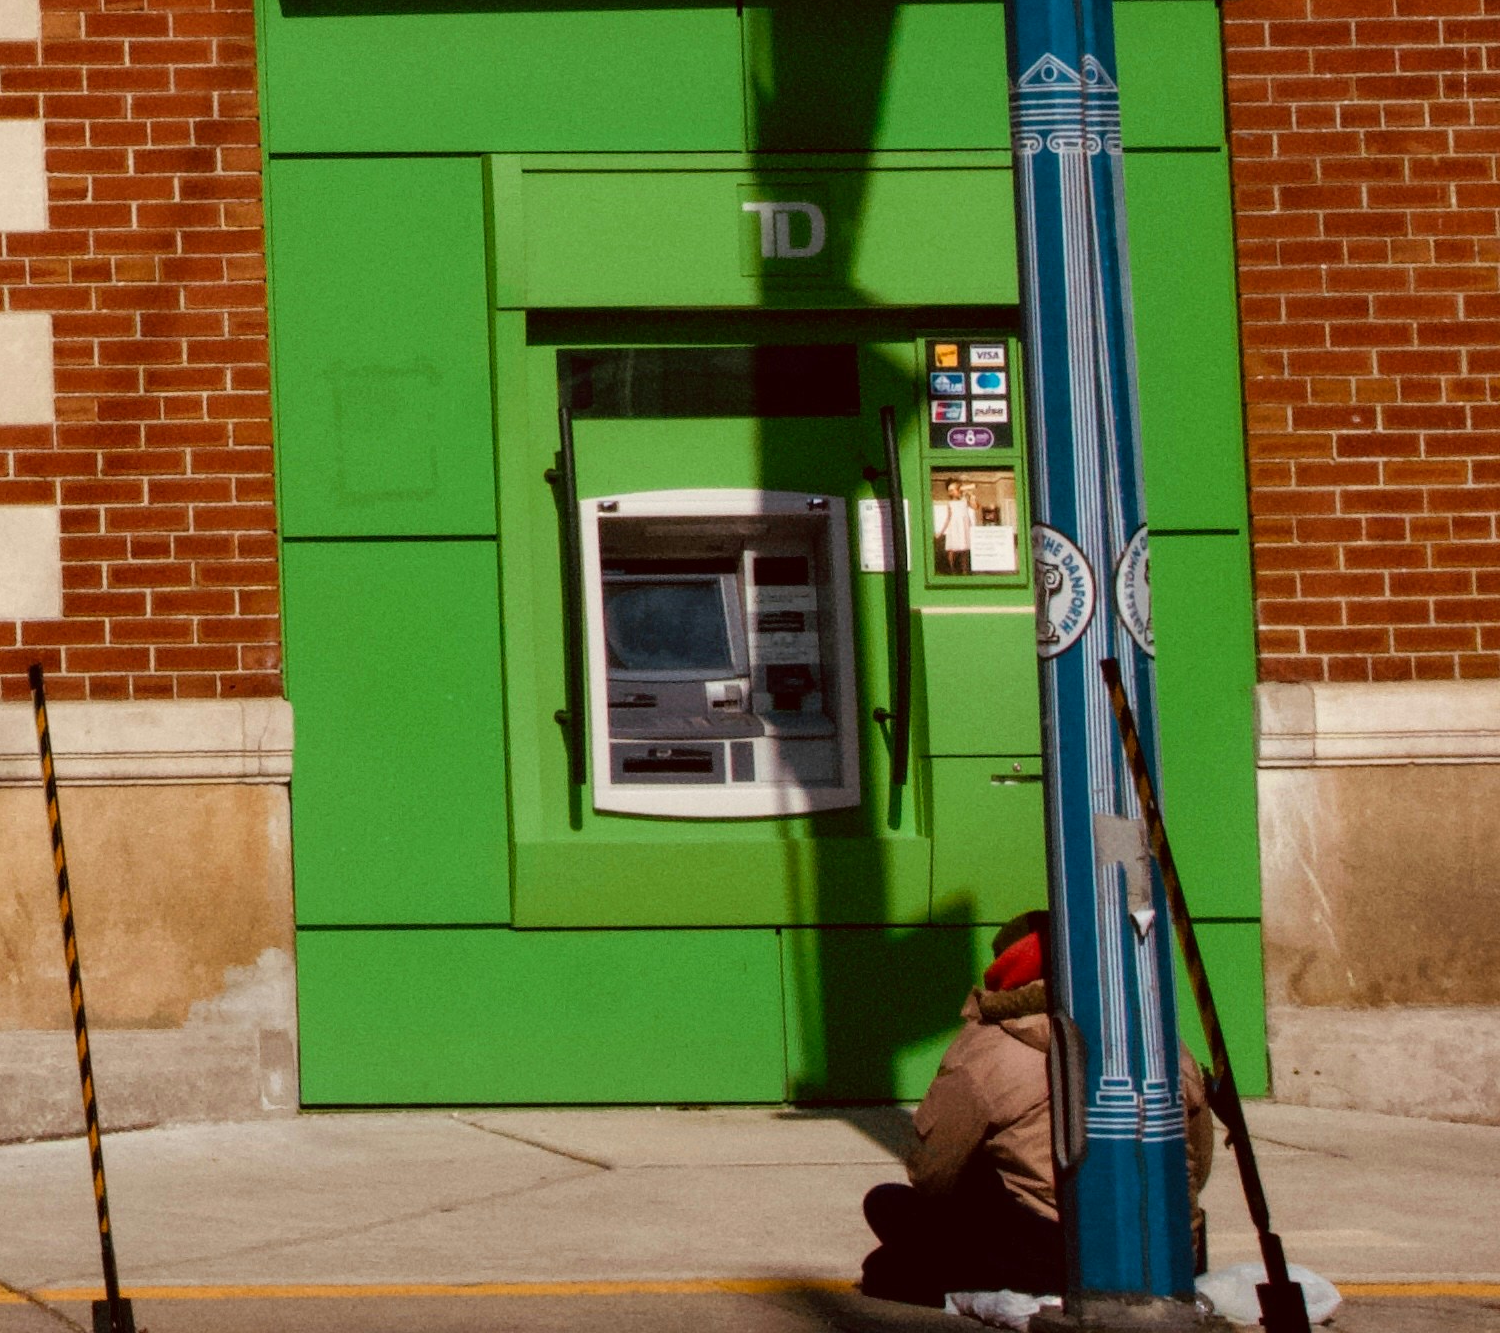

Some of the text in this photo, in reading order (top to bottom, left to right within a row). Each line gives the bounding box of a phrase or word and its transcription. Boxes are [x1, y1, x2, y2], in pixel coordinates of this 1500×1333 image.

[741, 201, 826, 259] TD
[975, 350, 1001, 360] VISA
[1058, 552, 1086, 636] DANFORTH
